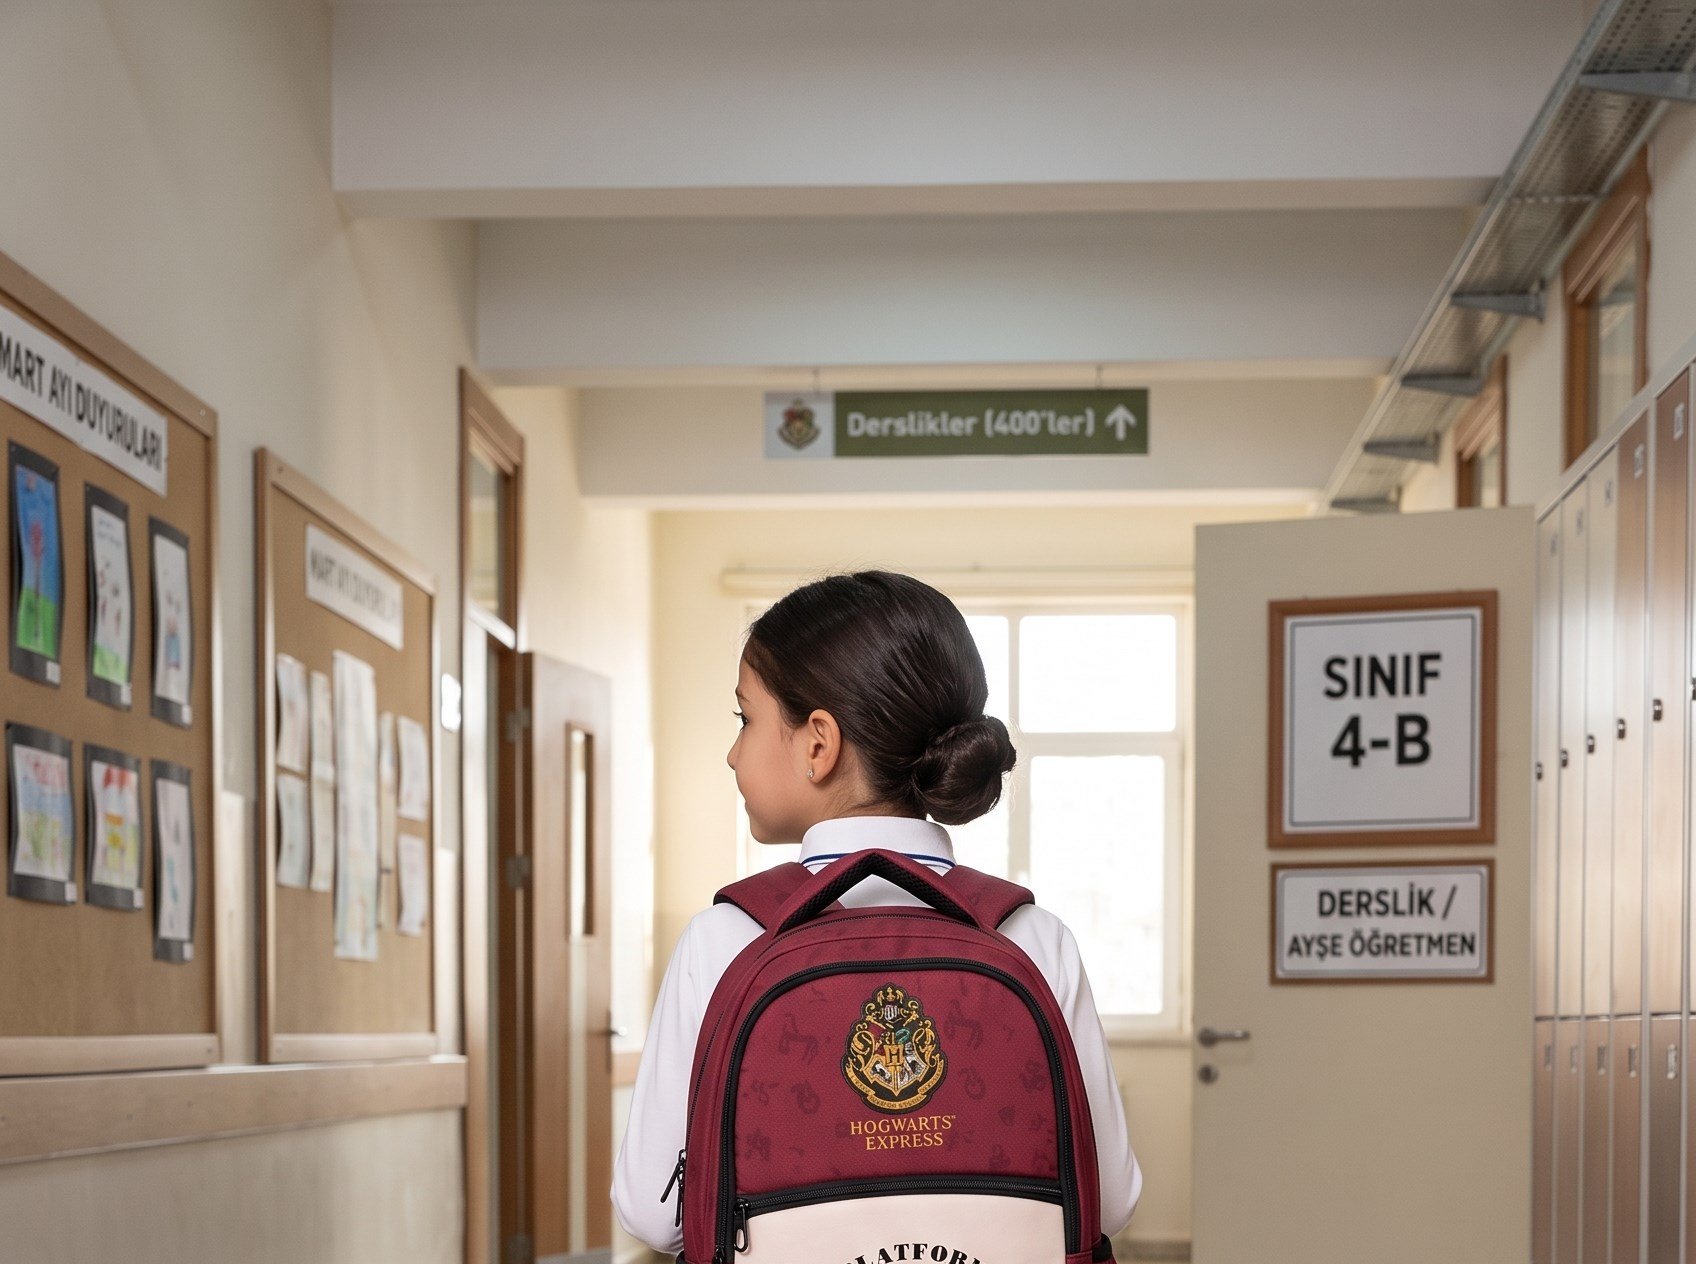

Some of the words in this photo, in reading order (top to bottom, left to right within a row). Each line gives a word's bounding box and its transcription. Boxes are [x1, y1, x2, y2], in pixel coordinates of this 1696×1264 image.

[0, 331, 45, 397] MART
[49, 365, 72, 416] AYI
[847, 411, 978, 437] Derslikler
[985, 409, 1095, 437] (400'ler)
[1323, 652, 1442, 699] SINIF
[1331, 714, 1431, 768] 4-B
[1318, 883, 1435, 918] DERSLİK
[1287, 933, 1342, 962] AYŞE
[1350, 928, 1476, 958] ÖĞRETMEN
[866, 1132, 944, 1151] EXPRESS
